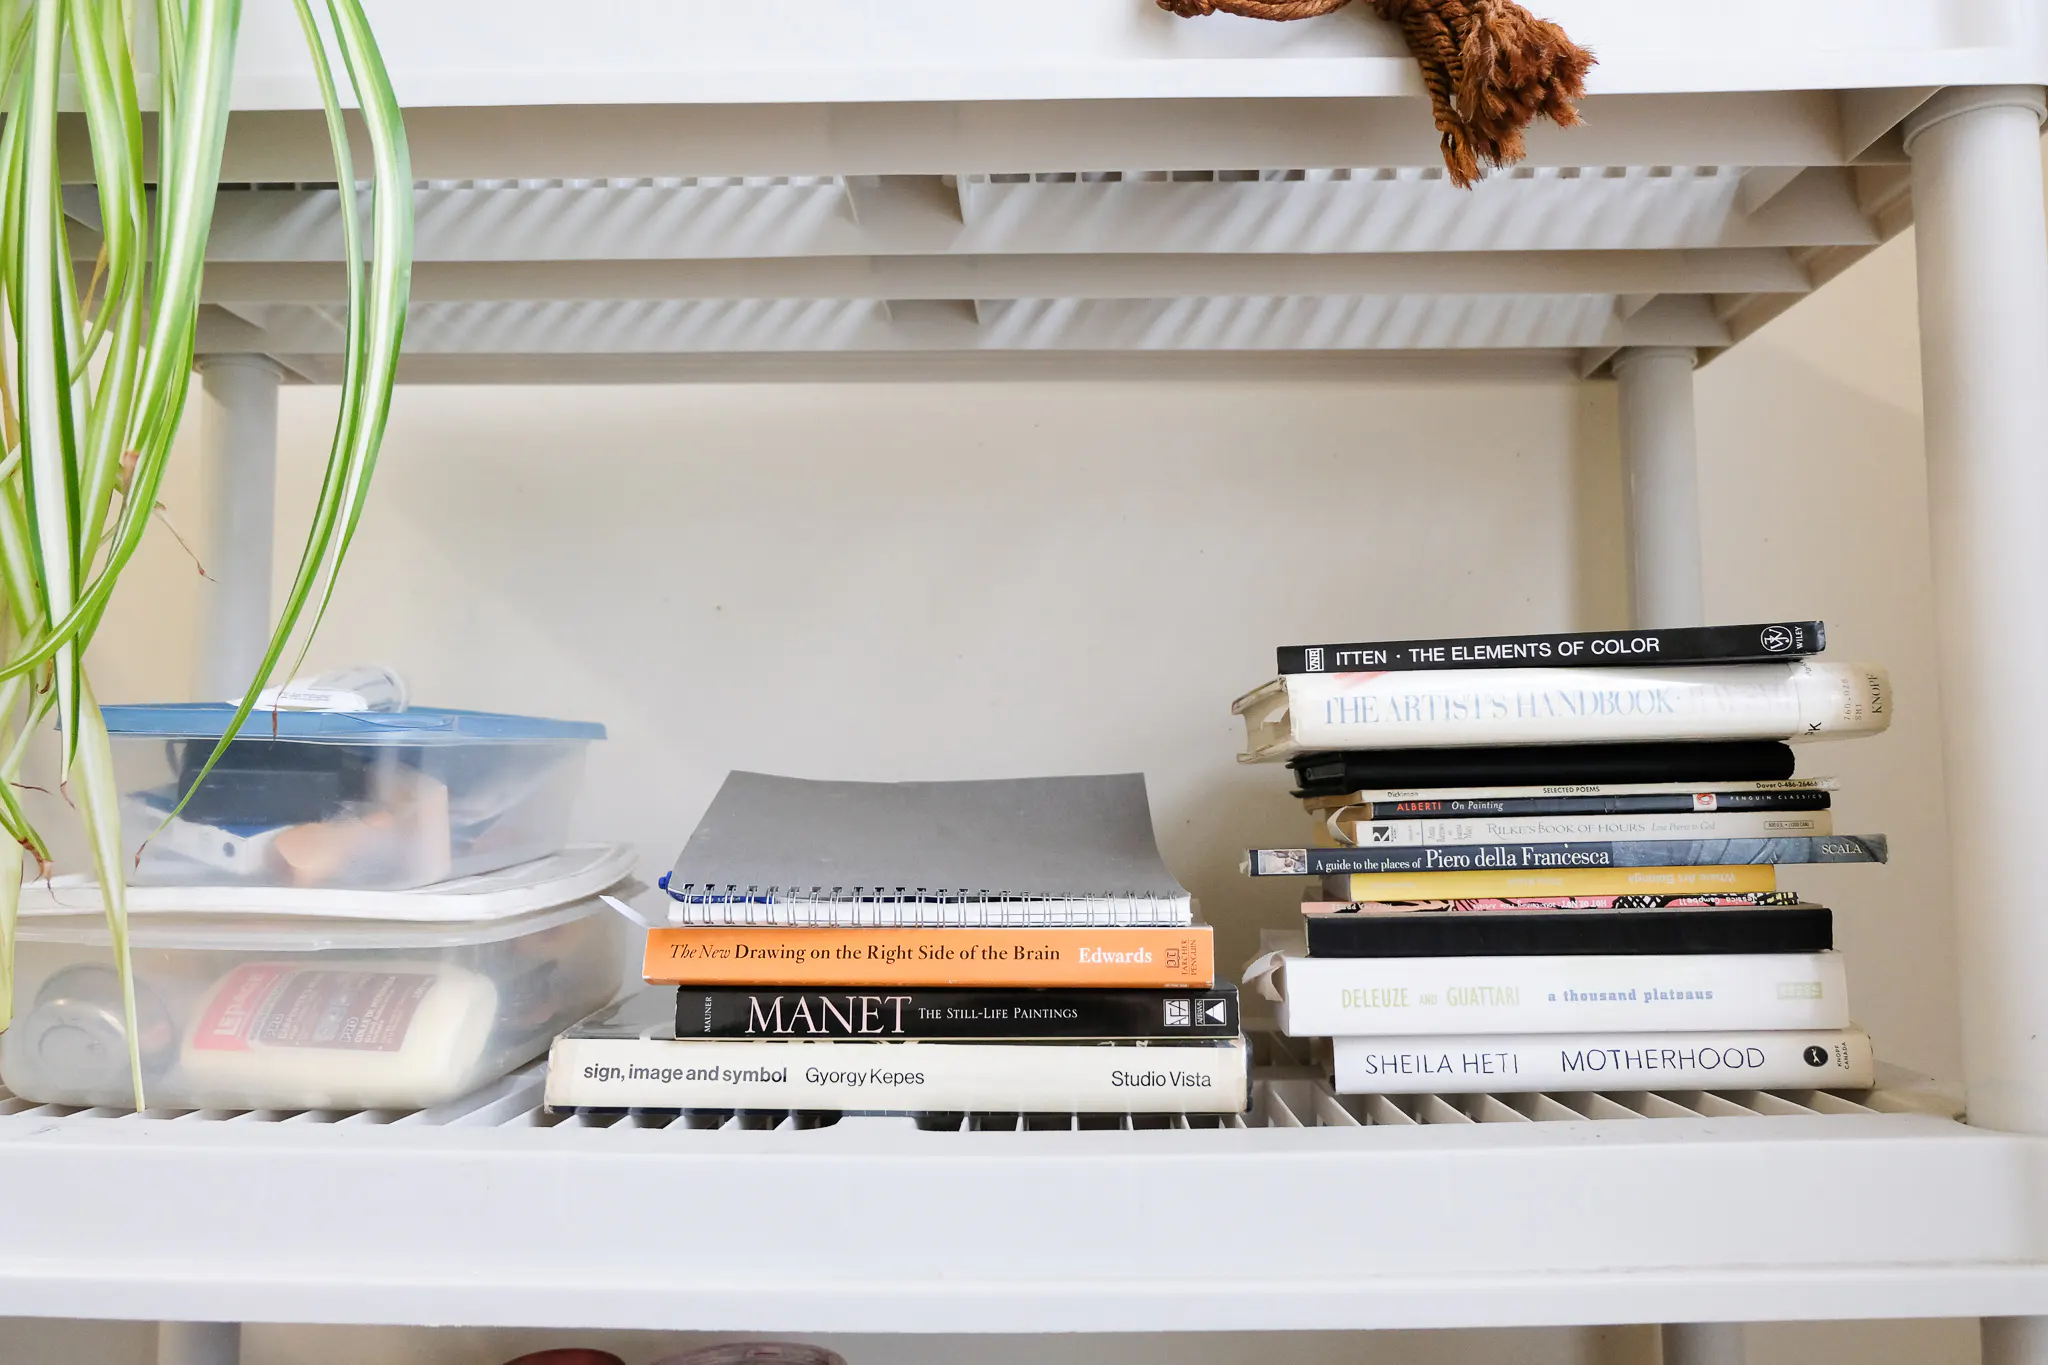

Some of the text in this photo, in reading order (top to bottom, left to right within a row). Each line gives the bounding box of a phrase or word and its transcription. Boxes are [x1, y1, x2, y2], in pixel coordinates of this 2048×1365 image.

[1795, 626, 1803, 650] WILEY
[1335, 637, 1660, 666] ITTEN THE ELEMENTS OF COLOR
[1325, 694, 1381, 724] THE
[1384, 692, 1508, 722] ARTIST'S
[1517, 688, 1675, 718] HANDBOOK
[1866, 674, 1883, 714] KNOPF
[1576, 785, 1600, 793] POEMS
[1396, 801, 1442, 811] ALBERTI
[1451, 801, 1464, 810] On
[1467, 800, 1504, 812] Painting
[1578, 823, 1591, 833] OF
[1598, 822, 1646, 833] HOURS
[1315, 843, 1863, 872] A guide to the places of Piero della Francesca SCALA
[670, 943, 1153, 964] The New Drawing on the Right Side of the Brain Edwards
[1341, 988, 1410, 1009] DELEUZE
[1446, 985, 1520, 1008] GUATTARI
[1548, 991, 1556, 1002] a
[1563, 988, 1637, 1003] thousand
[1643, 987, 1714, 1004] plateaus
[704, 996, 713, 1033] MAUNER
[744, 994, 1078, 1035] MANET THE STILL-LIFE PAINTINGS
[1365, 1047, 1765, 1075] SHEILA HETI MOTHERHOOD
[1834, 1044, 1842, 1068] KNOPF
[583, 1063, 1212, 1088] sign, image and symbol Gyorgy Kepes Studio Vista
